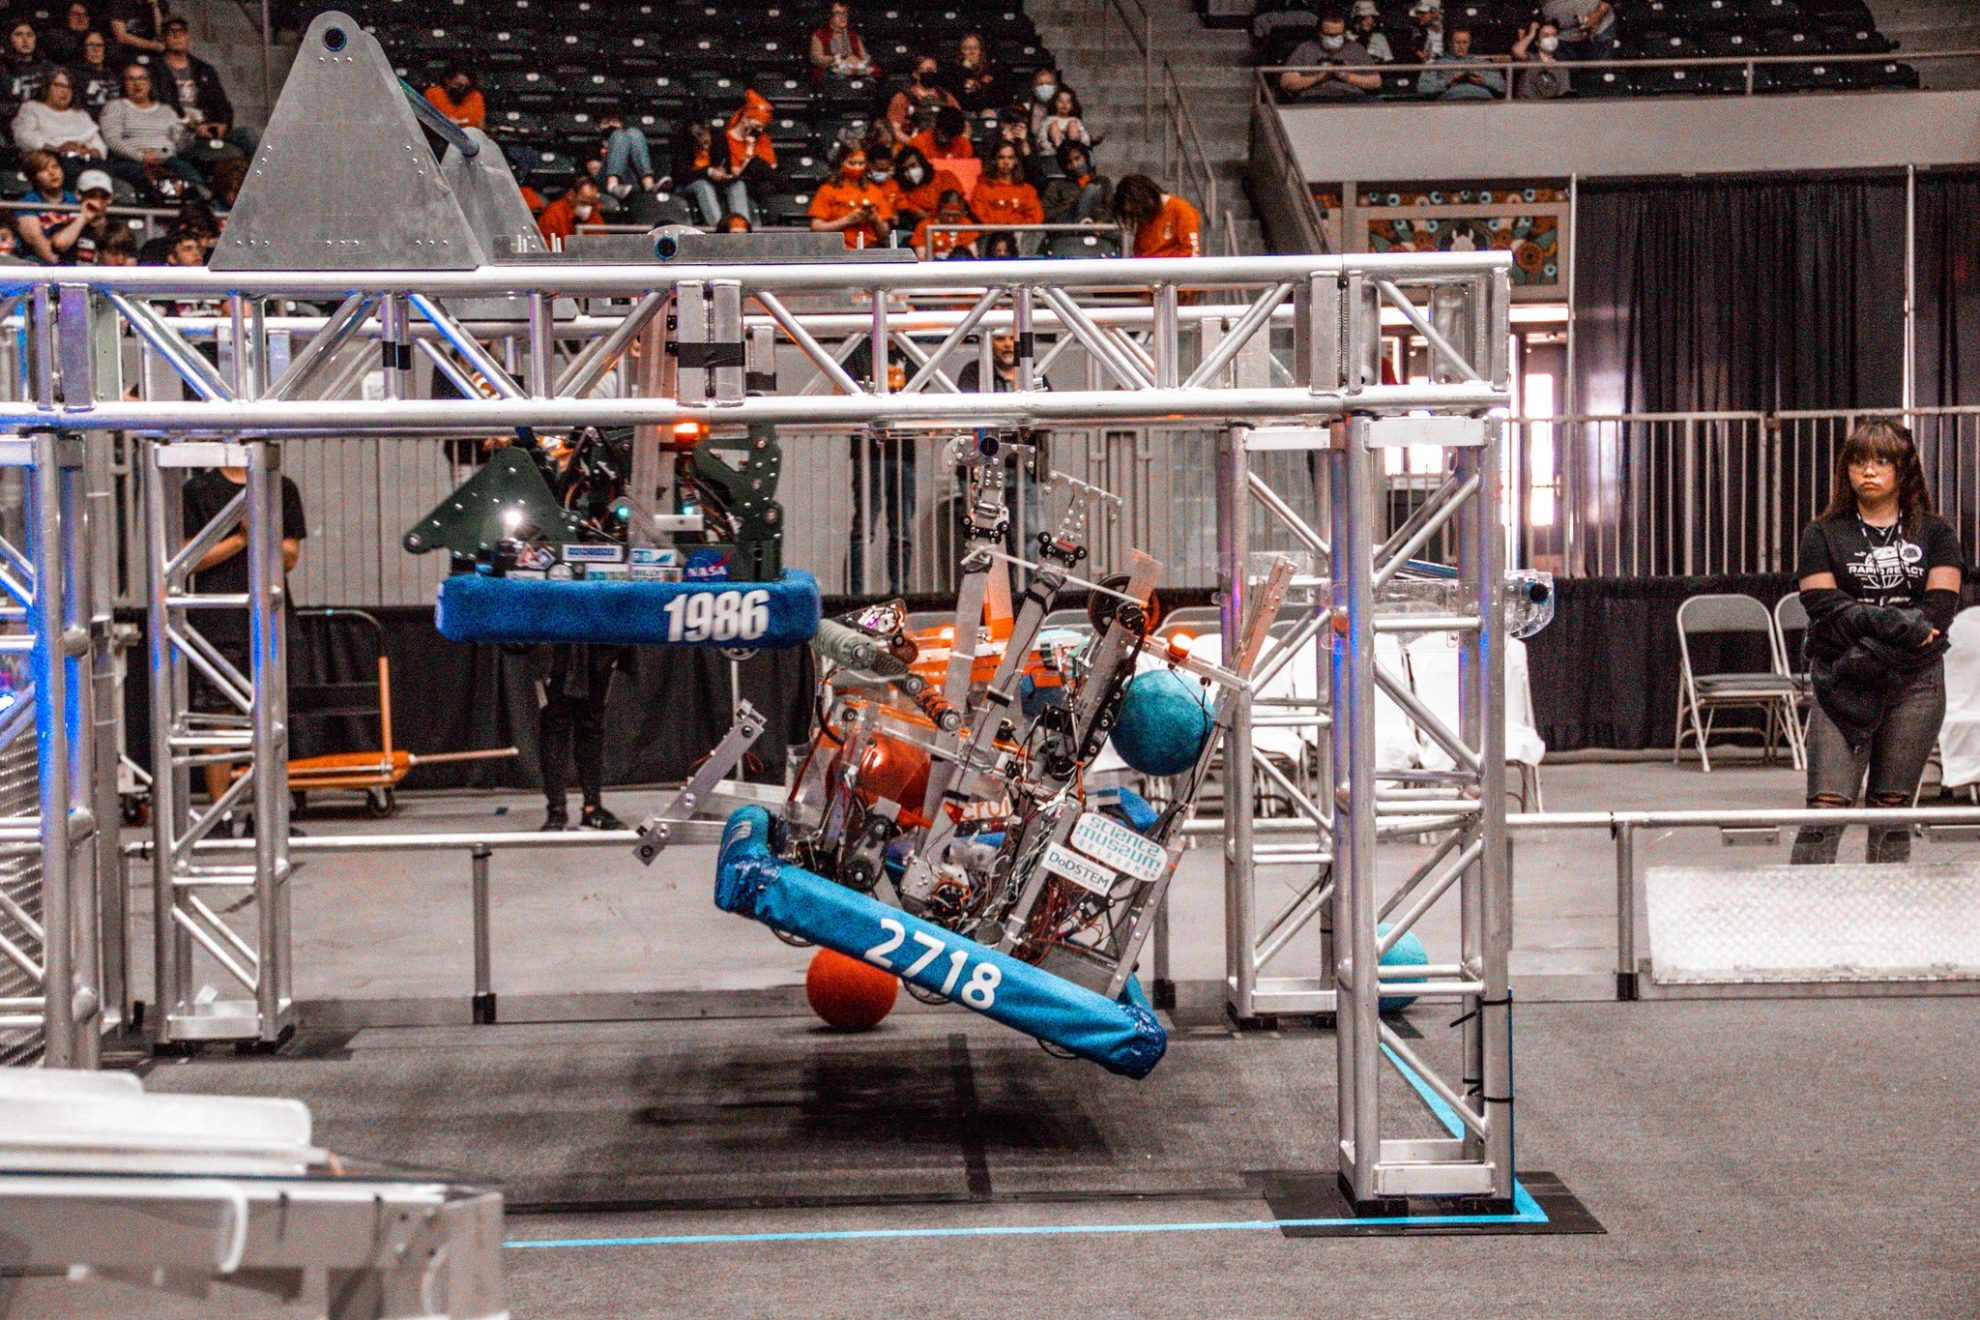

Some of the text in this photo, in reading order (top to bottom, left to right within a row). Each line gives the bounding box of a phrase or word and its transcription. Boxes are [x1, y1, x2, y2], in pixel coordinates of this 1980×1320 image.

[687, 565, 728, 577] NASA
[663, 589, 770, 642] 1986
[1048, 851, 1110, 889] DoDSTEM
[863, 918, 1002, 1010] 2718
